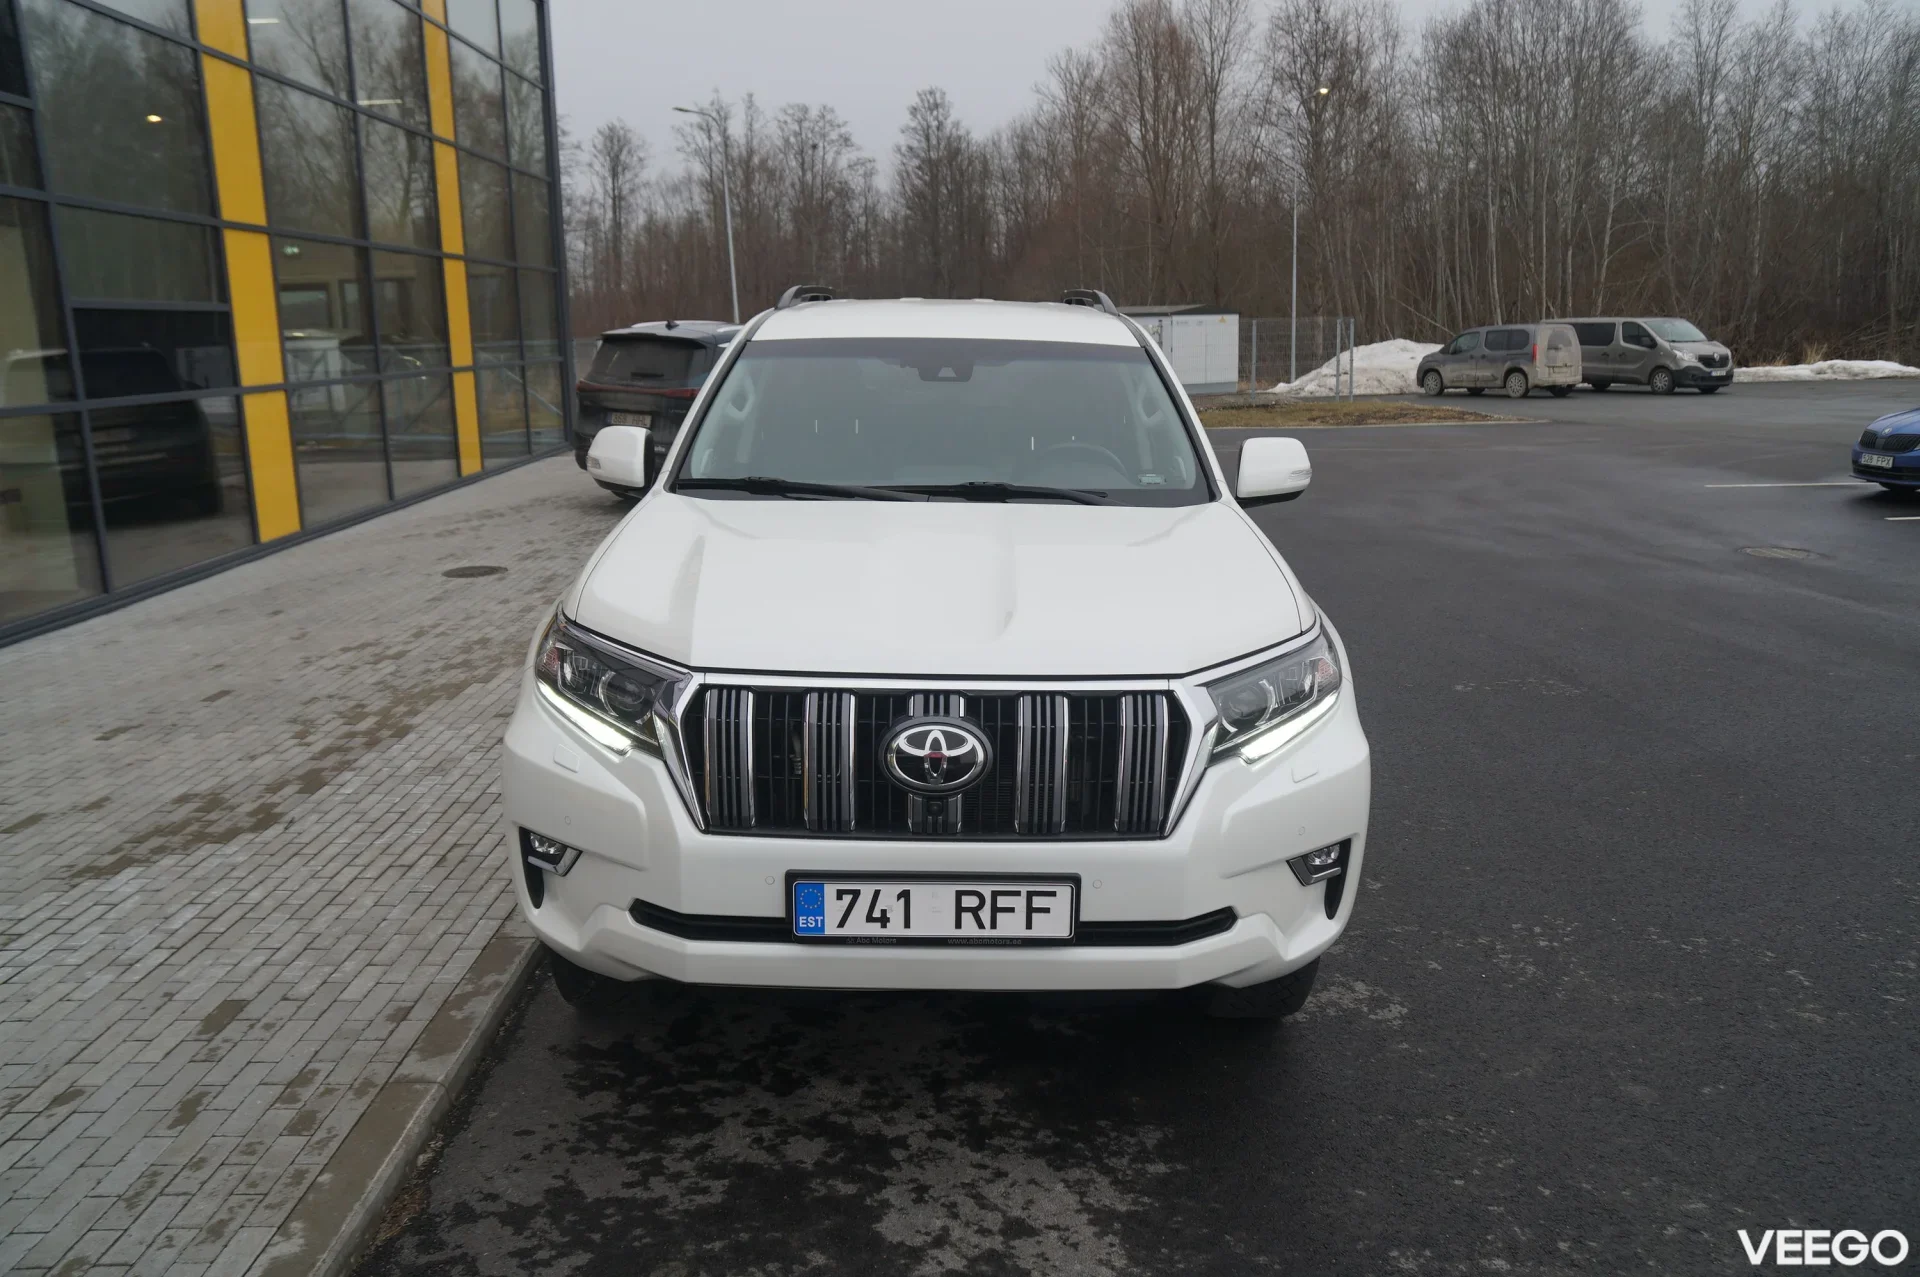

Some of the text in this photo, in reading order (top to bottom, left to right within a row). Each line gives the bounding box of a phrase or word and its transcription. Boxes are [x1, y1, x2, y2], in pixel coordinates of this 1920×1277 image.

[799, 916, 824, 927] EST
[836, 888, 1057, 930] 741 RFF
